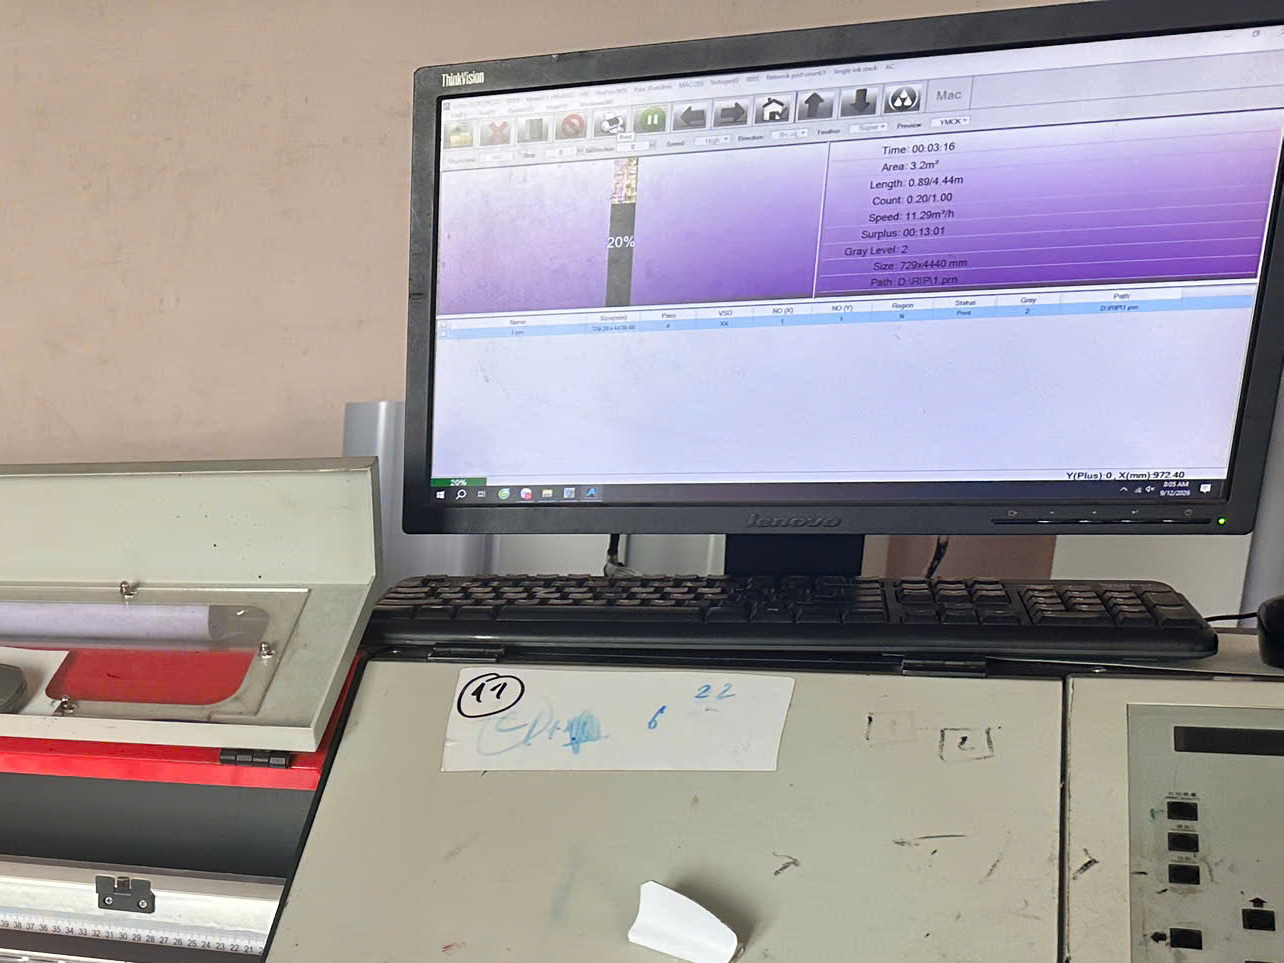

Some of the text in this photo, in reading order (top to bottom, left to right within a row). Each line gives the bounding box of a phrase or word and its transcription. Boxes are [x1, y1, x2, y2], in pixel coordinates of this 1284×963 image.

[442, 71, 485, 87] ThinkVision
[936, 89, 962, 101] Mac
[912, 142, 956, 154] 00:03:16
[908, 176, 964, 187] 0.89/4.44m
[907, 193, 953, 204] 0.20/1.00
[903, 226, 946, 237] 00:13:01
[607, 236, 635, 248] 20%
[844, 247, 868, 257] Gray
[901, 245, 908, 254] 2
[900, 259, 947, 270] 729x4440
[948, 259, 968, 268] mm
[747, 514, 842, 528] lenovo
[0, 919, 9, 927] 39
[13, 921, 22, 929] 38
[26, 922, 35, 930] 37
[39, 923, 48, 931] 36
[52, 925, 61, 933] 35
[65, 926, 74, 934] 34
[78, 928, 87, 936] 33
[91, 929, 101, 937] 32
[105, 930, 114, 938] 31
[118, 932, 127, 940] 30
[132, 933, 141, 941] 29
[146, 934, 155, 943] 28
[159, 936, 169, 944] 27
[173, 937, 183, 946] 26
[187, 939, 197, 947] 25
[201, 940, 211, 949] 24
[216, 942, 225, 950] 23
[230, 943, 239, 952] 22
[244, 945, 253, 953] 21
